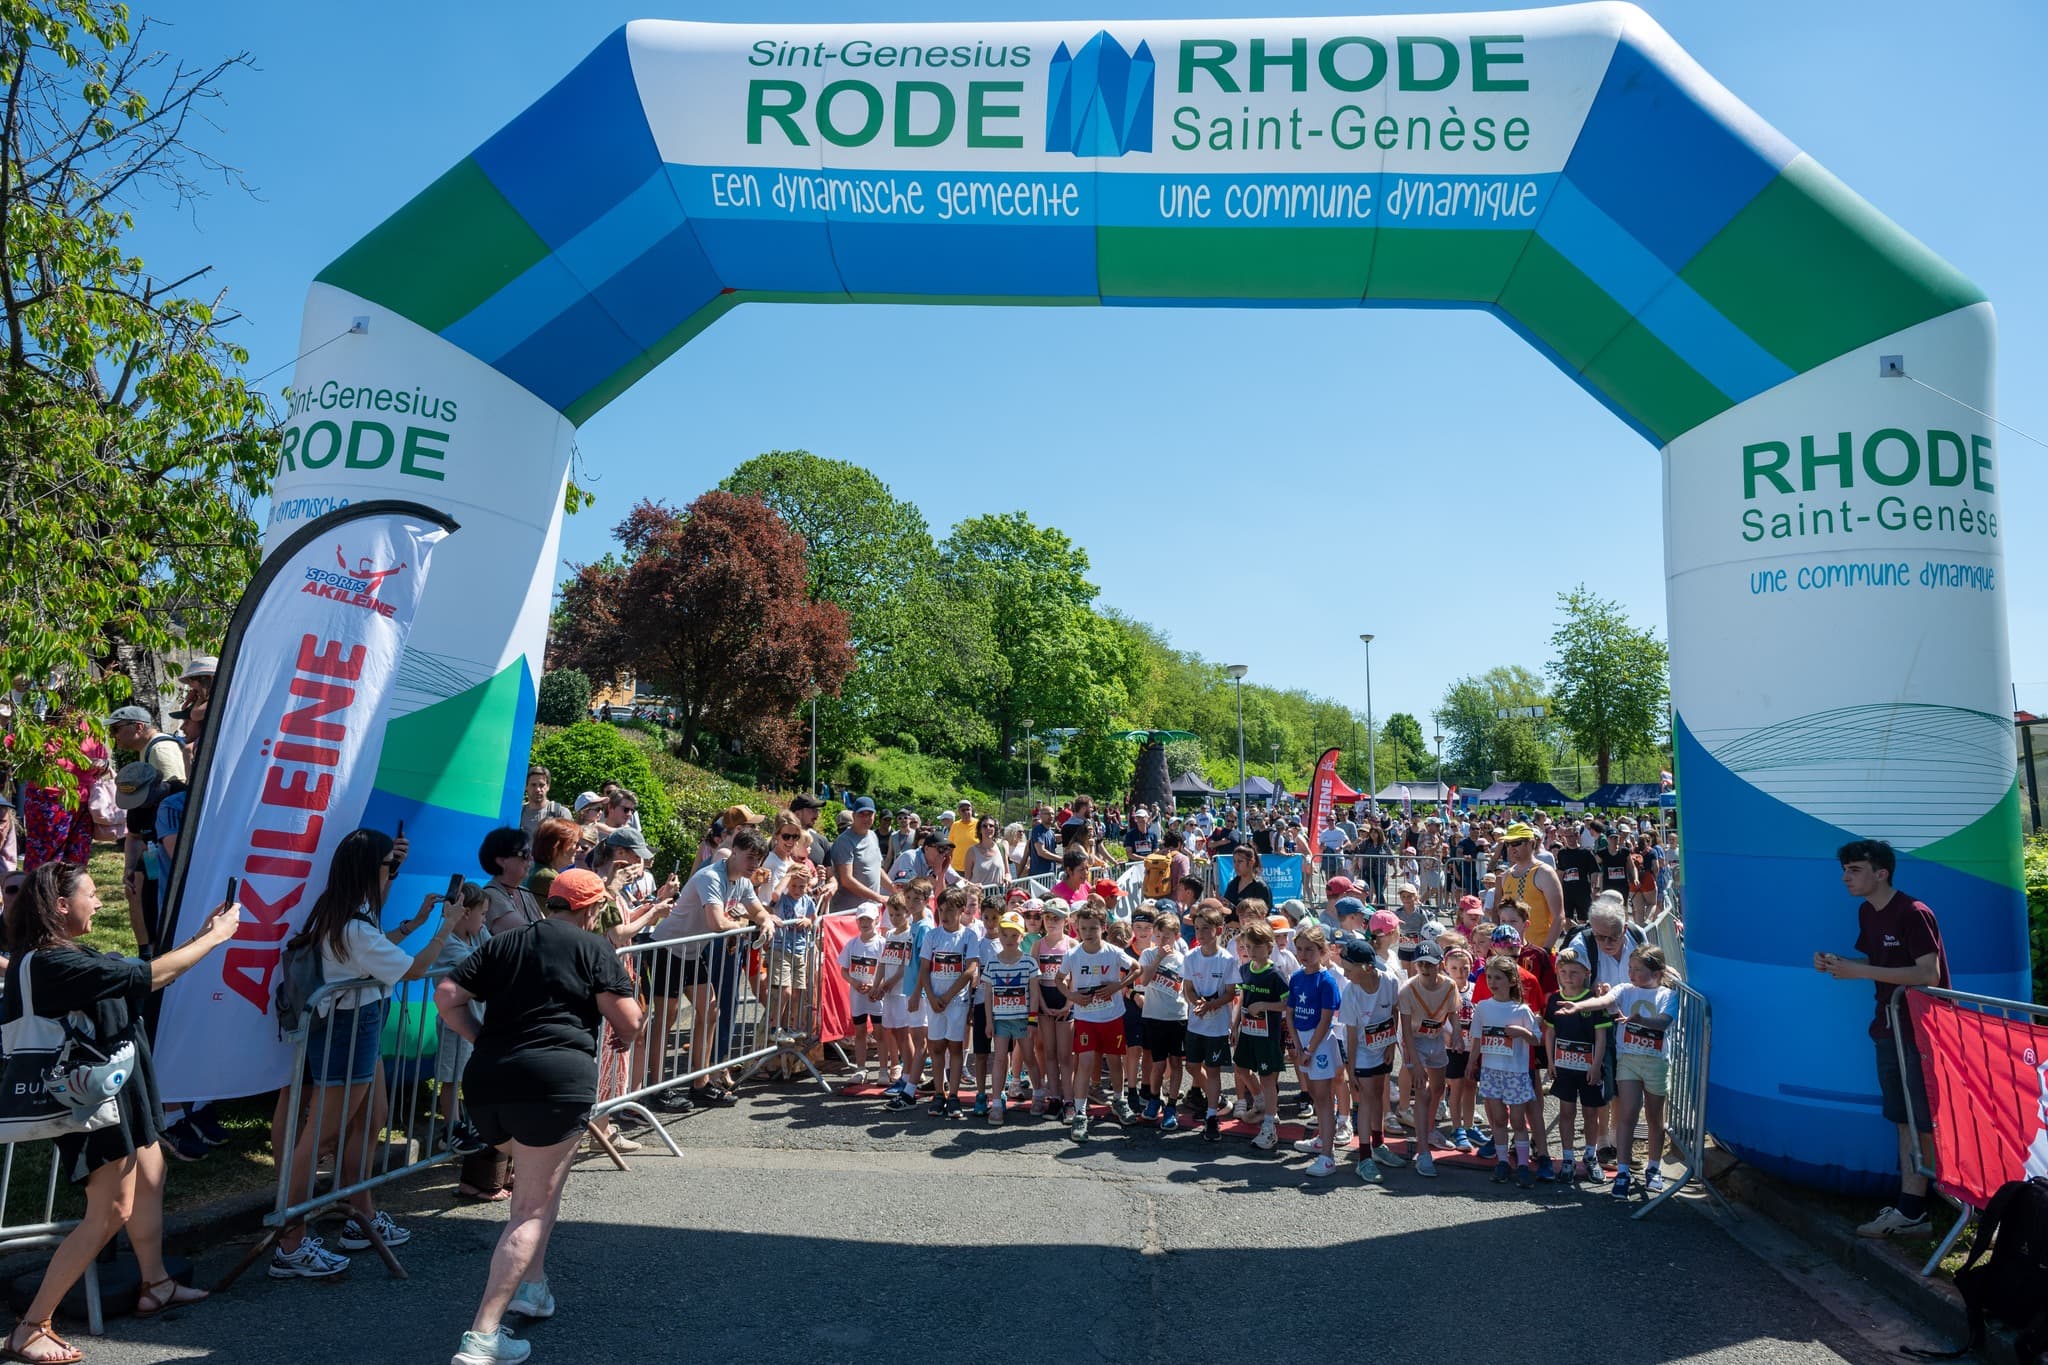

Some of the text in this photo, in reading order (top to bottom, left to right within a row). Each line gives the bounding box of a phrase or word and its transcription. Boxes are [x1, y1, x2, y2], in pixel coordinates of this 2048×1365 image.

[747, 40, 1031, 68] Sint-Genesius
[1177, 34, 1530, 93] RHODE
[746, 79, 1025, 149] RODE
[1171, 104, 1530, 152] Saint-Genèse
[711, 172, 1080, 219] Een dynamische gemeente
[1159, 178, 1538, 221] une commune dynamique
[287, 380, 458, 422] Sint-Genesius
[278, 420, 450, 481] RODE
[1742, 428, 1995, 499] RHODE
[1741, 496, 1998, 542] Saint-Genèse
[305, 568, 367, 592] SPORTS
[1750, 560, 1995, 594] une commune dynamique
[222, 633, 367, 1015] AKILEÏNE
[998, 997, 1020, 1006] 1549
[1371, 1030, 1392, 1042] 1627
[1484, 1036, 1504, 1046] 1782
[1561, 1050, 1586, 1062] 1886
[1631, 1034, 1655, 1048] 1293
